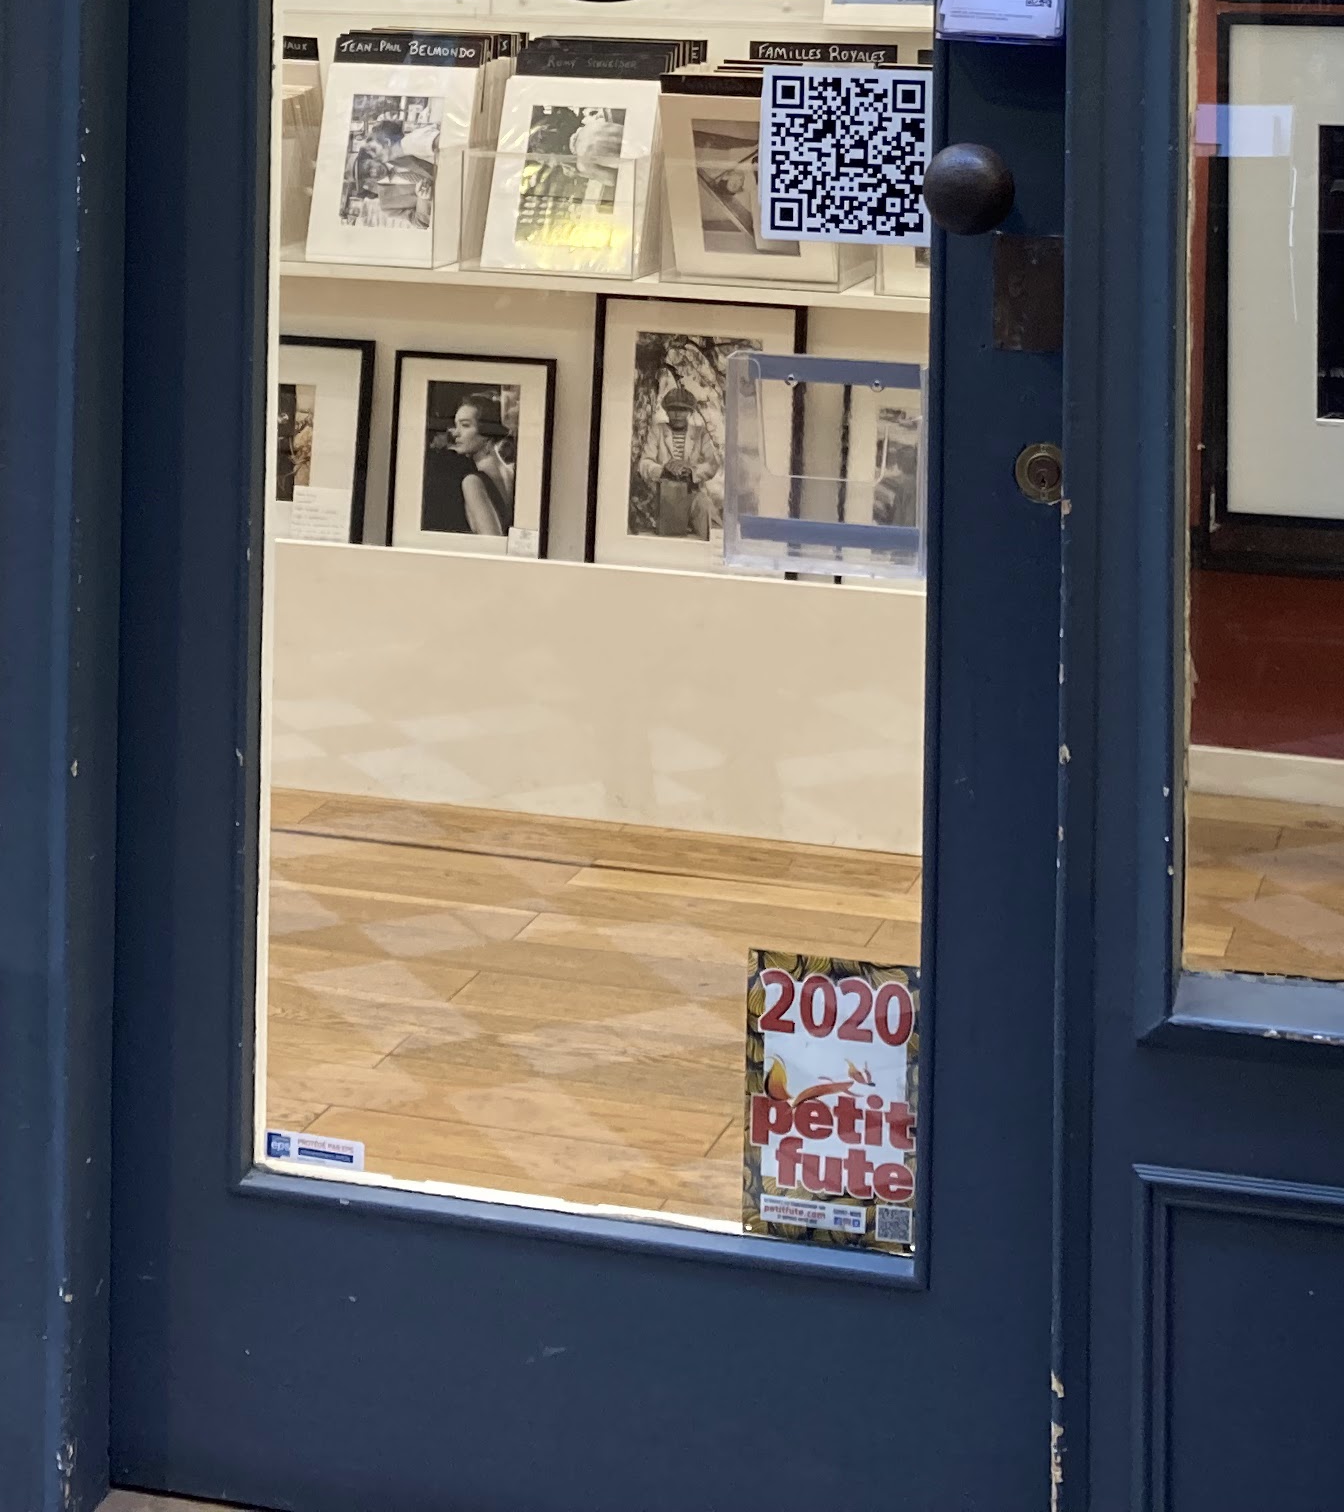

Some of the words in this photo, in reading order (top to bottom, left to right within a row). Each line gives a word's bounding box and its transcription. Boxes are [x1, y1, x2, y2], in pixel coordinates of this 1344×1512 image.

[408, 40, 476, 59] BELMONDO
[828, 45, 886, 63] ROYALES
[758, 968, 915, 1047] 2020
[750, 1094, 916, 1151] petit
[775, 1137, 916, 1203] fute
[763, 1204, 826, 1220] petitfute.com
